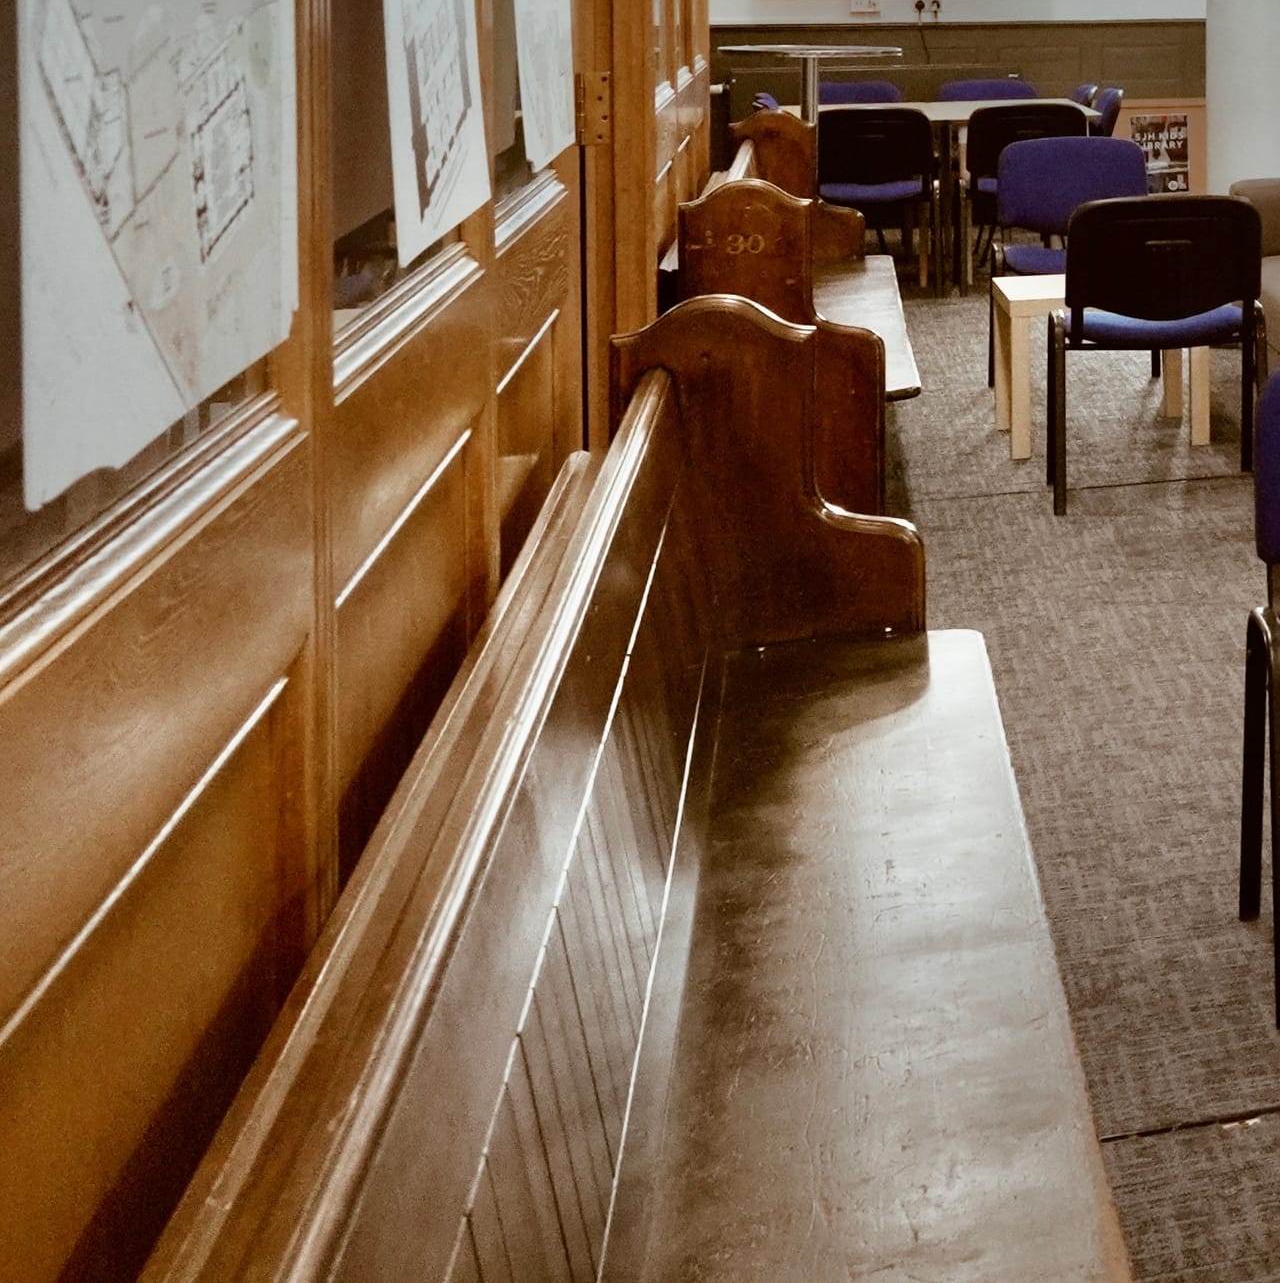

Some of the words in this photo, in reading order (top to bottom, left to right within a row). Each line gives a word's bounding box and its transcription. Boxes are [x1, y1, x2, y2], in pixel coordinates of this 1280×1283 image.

[1135, 131, 1156, 142] SJH
[1158, 131, 1185, 140] KIDS
[1137, 140, 1184, 151] IBRARY
[726, 233, 766, 254] 30
